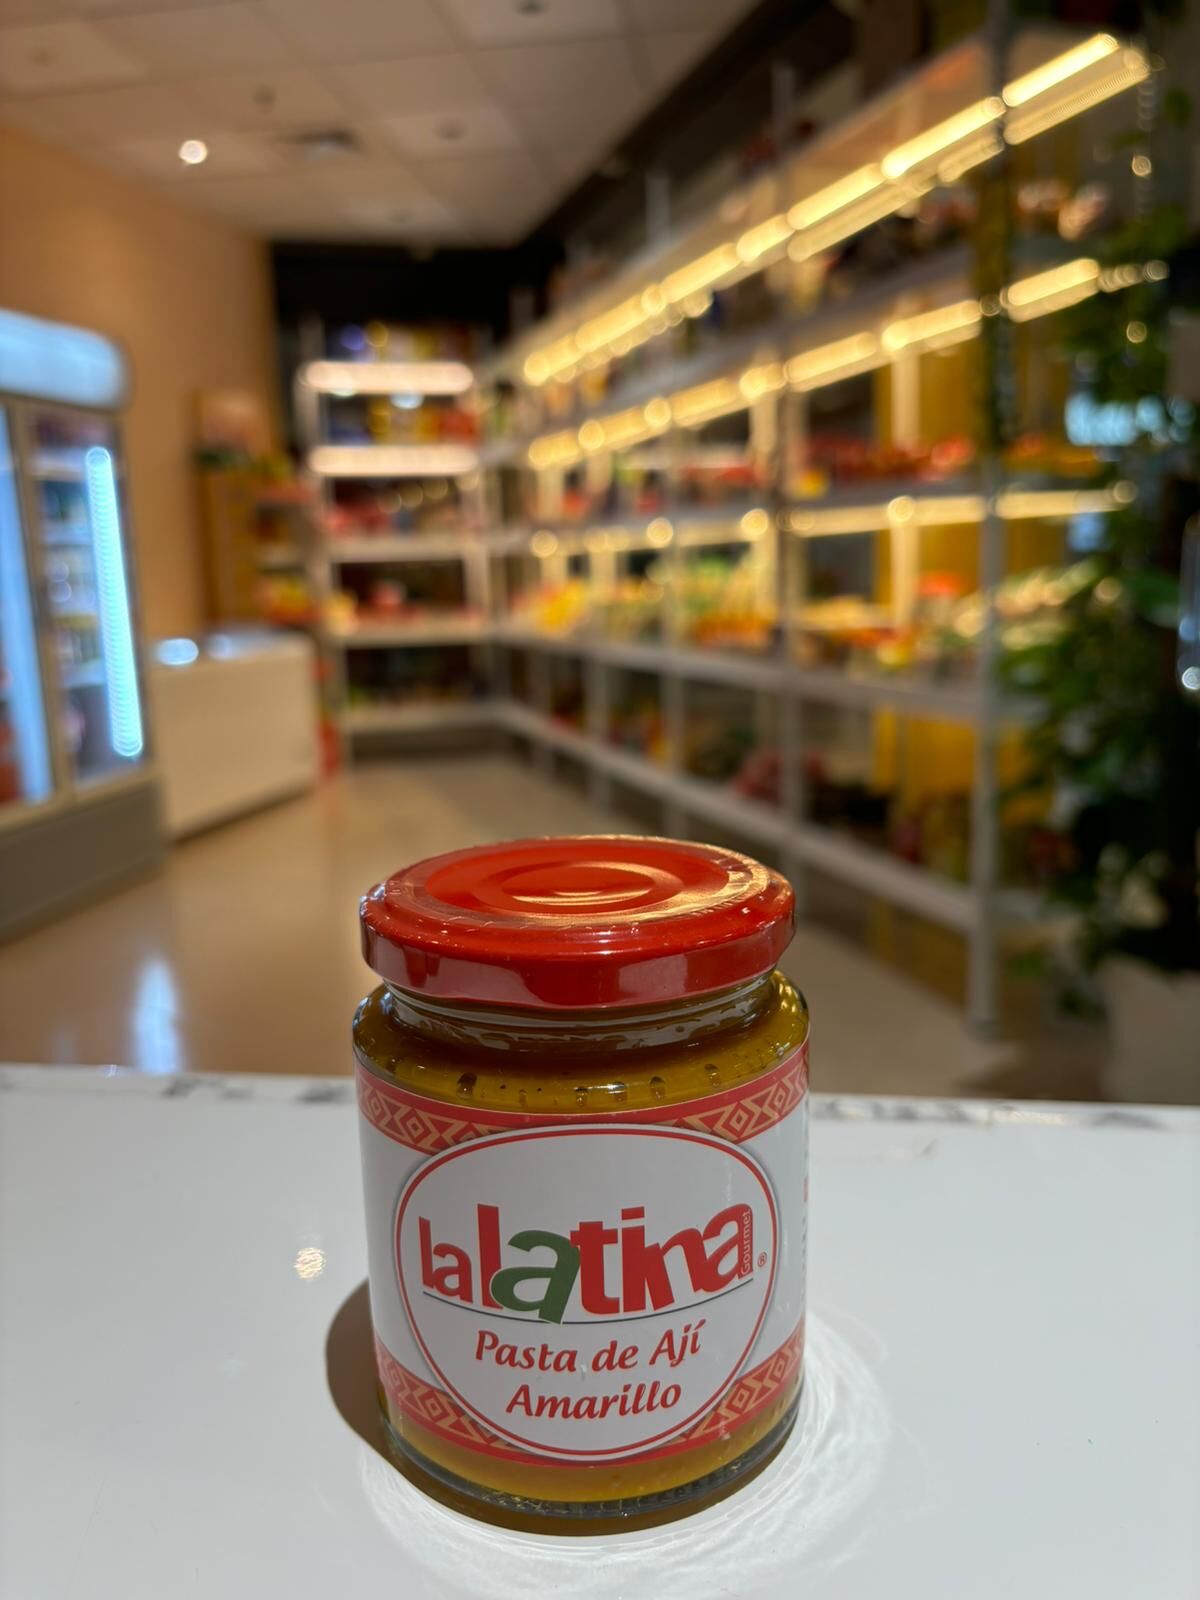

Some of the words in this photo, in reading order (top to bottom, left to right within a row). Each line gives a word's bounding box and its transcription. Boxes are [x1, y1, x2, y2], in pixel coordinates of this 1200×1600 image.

[740, 1209, 752, 1275] Gourmet
[475, 1330, 577, 1372] Pasta
[591, 1340, 638, 1371] de
[649, 1319, 706, 1367] Ají
[506, 1381, 682, 1419] Amarillo
